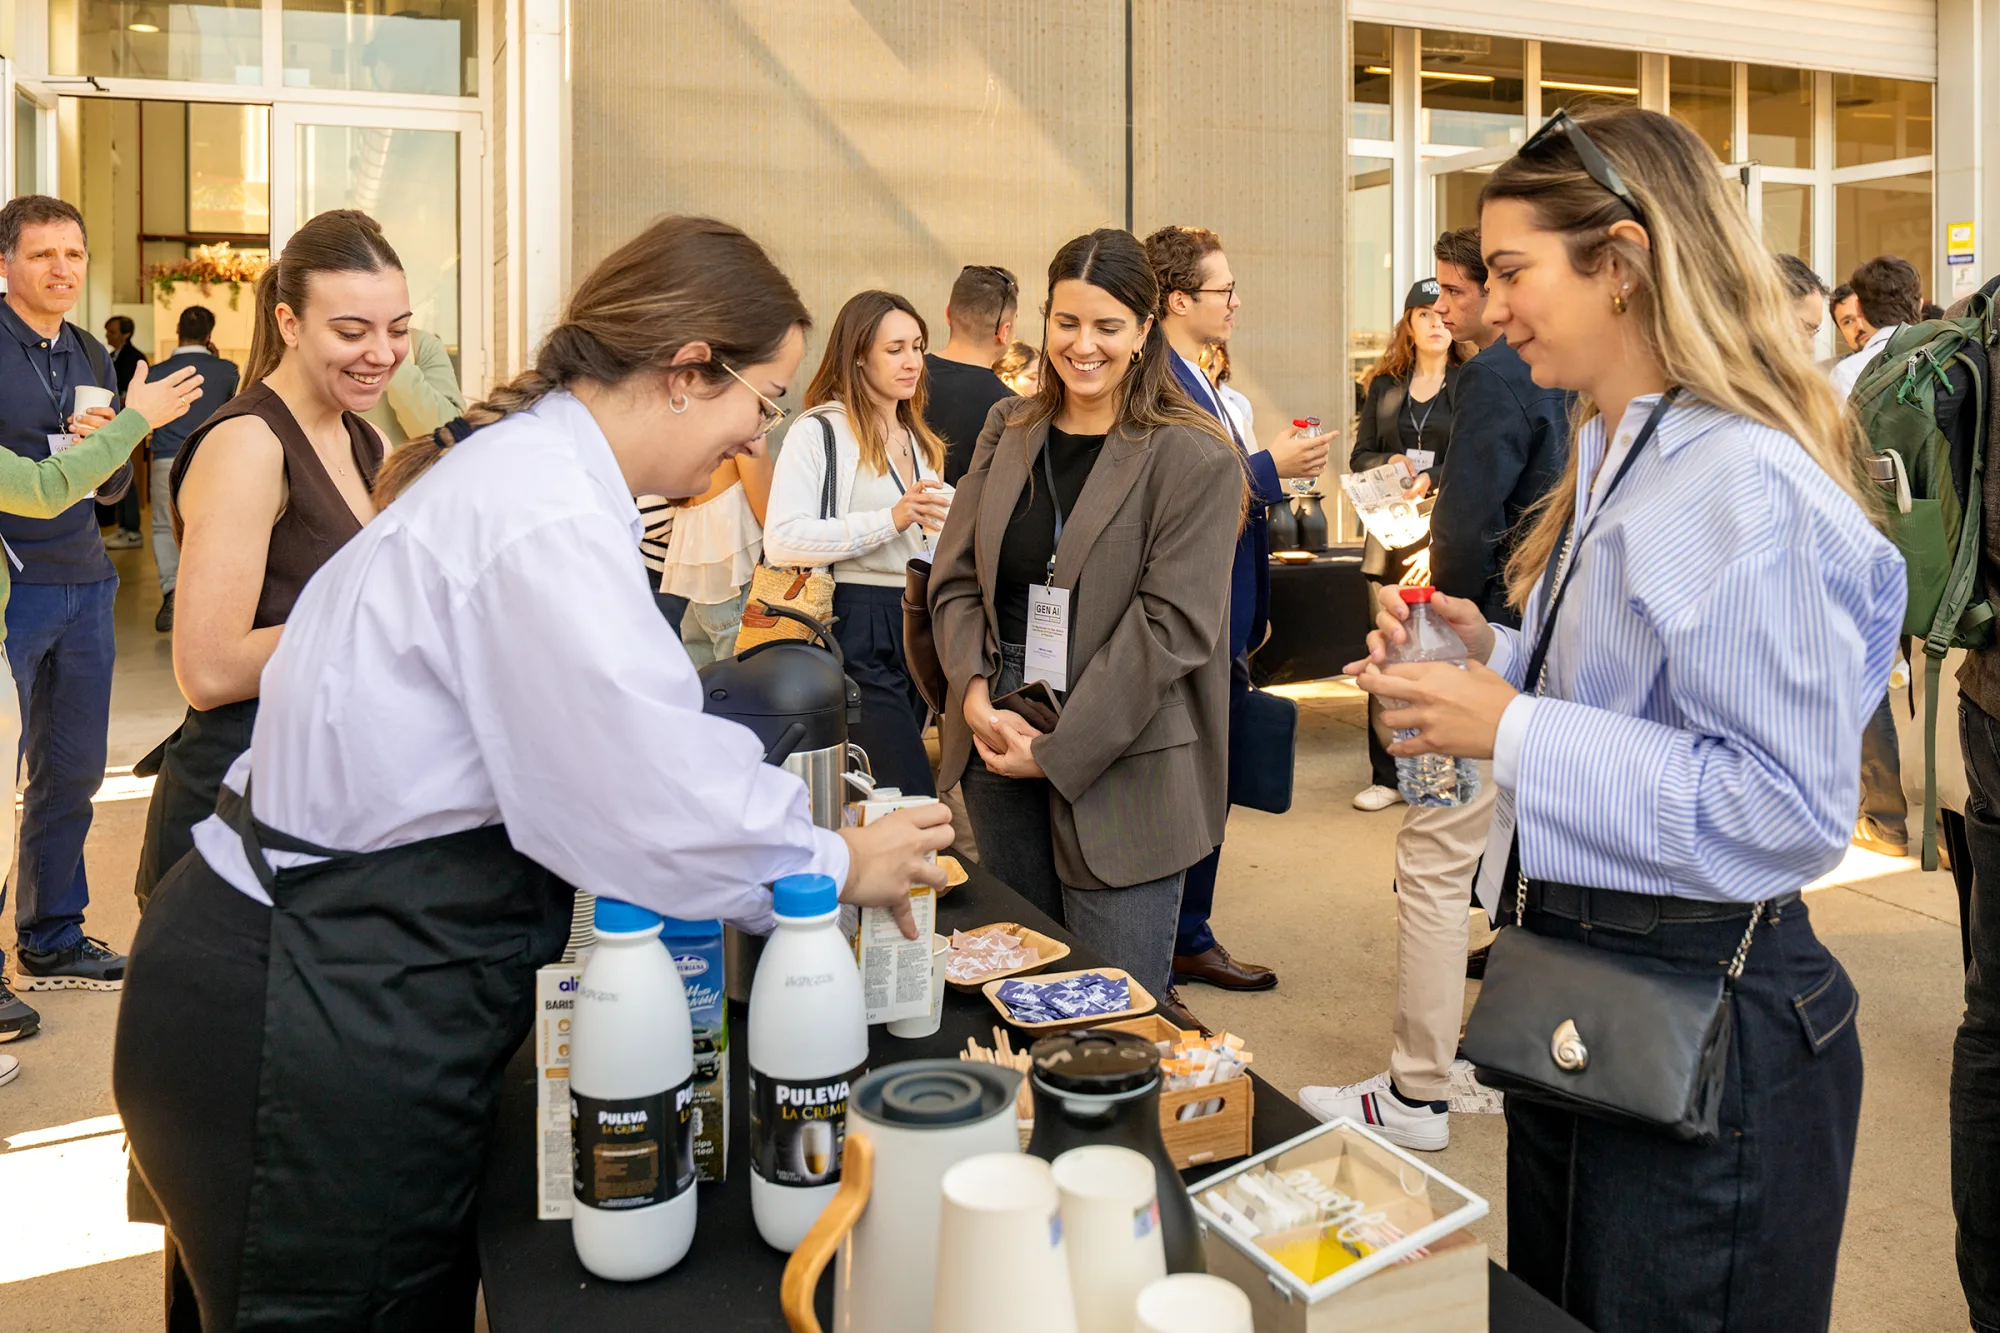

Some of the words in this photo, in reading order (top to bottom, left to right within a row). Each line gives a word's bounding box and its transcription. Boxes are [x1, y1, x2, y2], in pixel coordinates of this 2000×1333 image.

[1036, 604, 1051, 615] GEN
[1052, 607, 1060, 616] AI
[545, 999, 575, 1010] BARIS
[776, 1080, 851, 1106] PULEVA
[598, 1110, 648, 1125] PULEVA
[782, 1105, 798, 1120] LA
